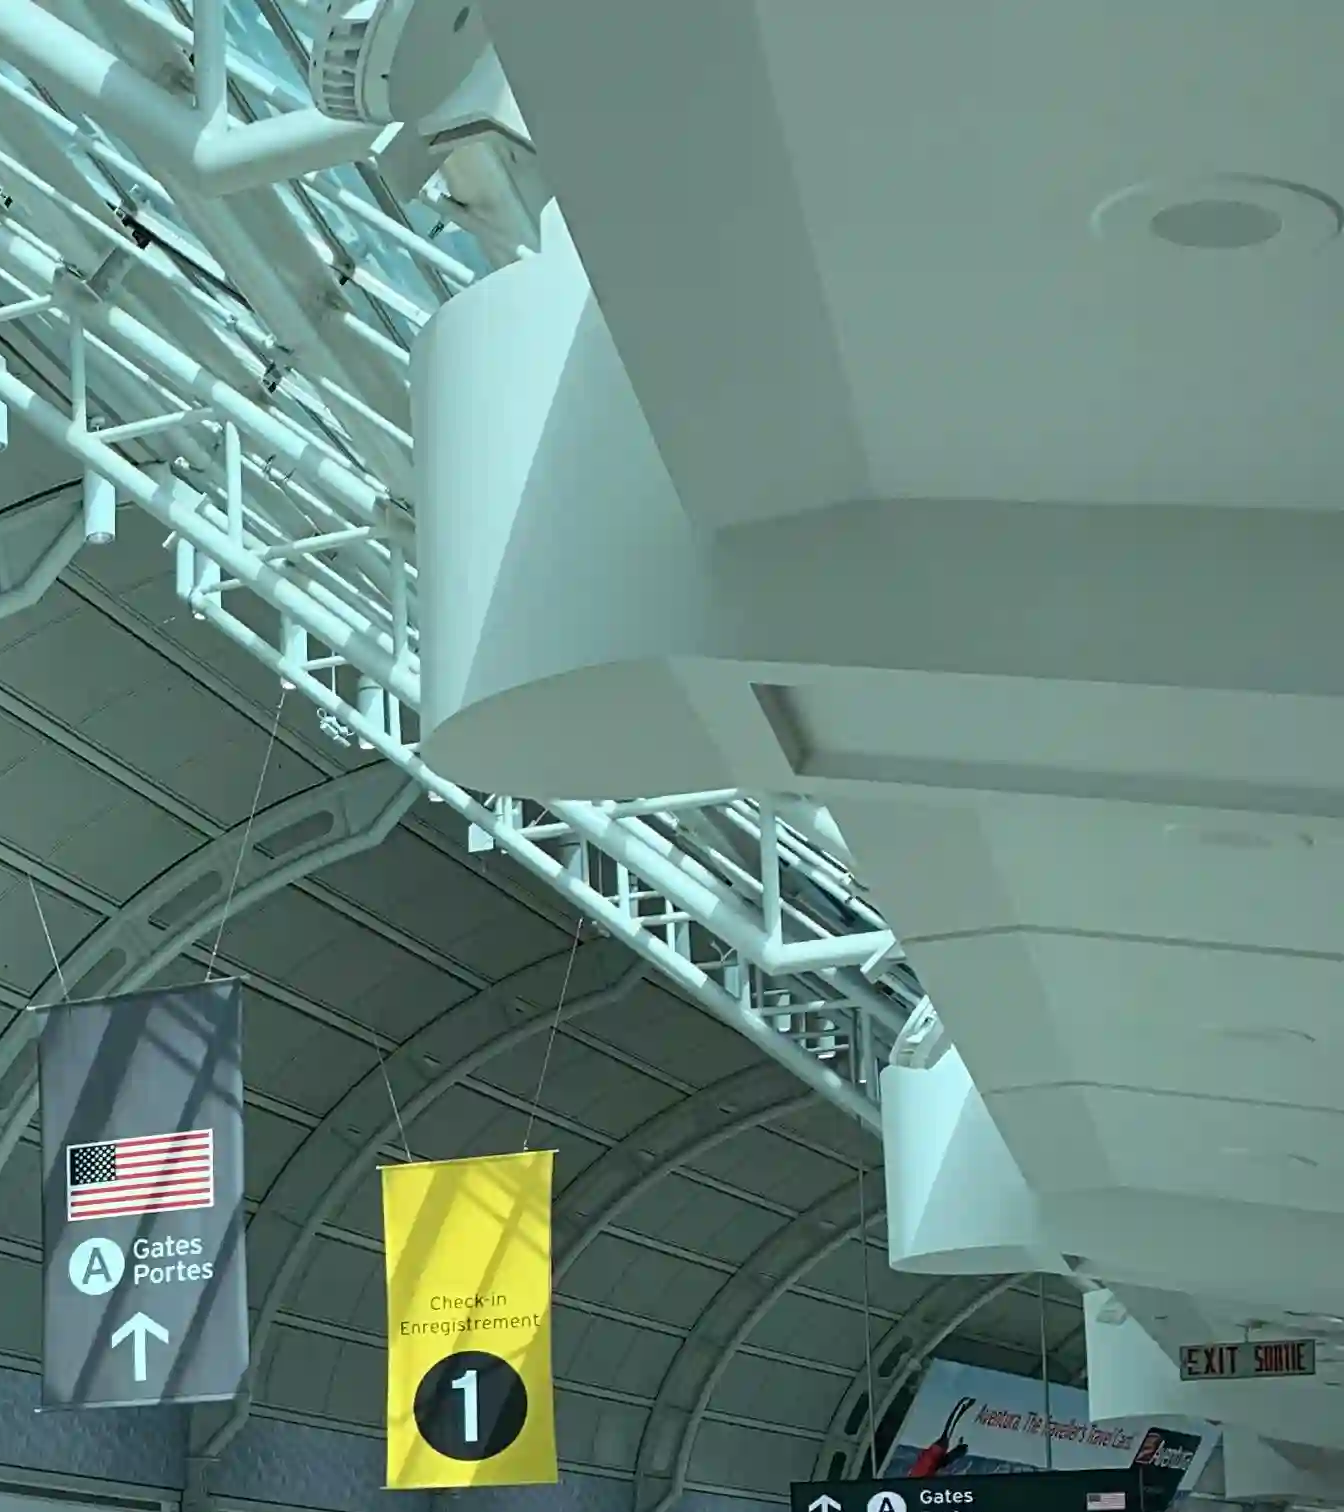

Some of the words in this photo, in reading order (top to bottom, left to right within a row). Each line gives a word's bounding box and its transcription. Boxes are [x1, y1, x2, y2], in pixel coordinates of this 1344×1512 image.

[133, 1236, 203, 1259] Gates
[82, 1247, 113, 1285] A
[133, 1259, 214, 1285] Portes
[429, 1290, 507, 1311] Check-in
[399, 1311, 541, 1337] Enregistrement
[1187, 1346, 1239, 1376] EXIT
[1254, 1342, 1307, 1373] SORTIE
[451, 1370, 480, 1443] 1
[920, 1489, 973, 1504] Gates
